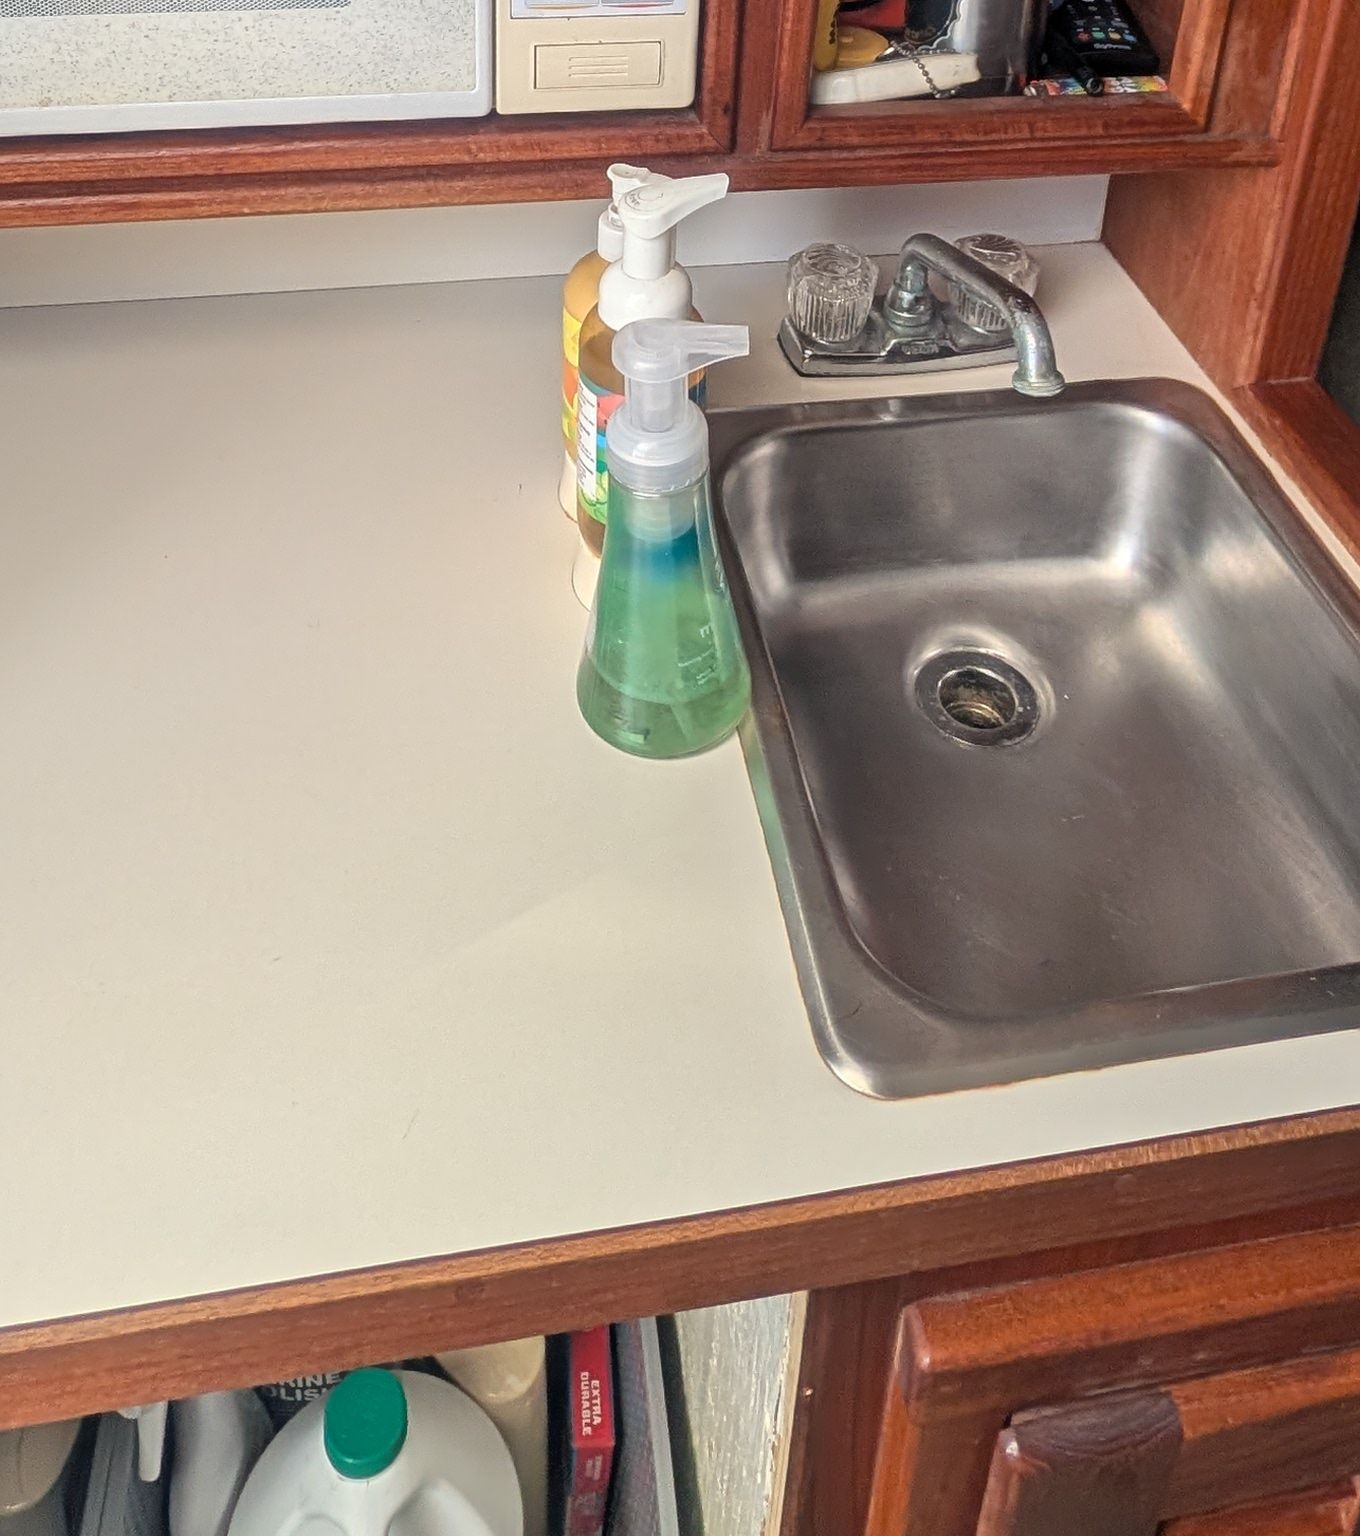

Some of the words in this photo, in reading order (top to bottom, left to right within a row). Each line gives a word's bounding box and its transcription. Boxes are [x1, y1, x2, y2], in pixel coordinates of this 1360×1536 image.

[267, 1387, 327, 1401] OLIS
[276, 1370, 342, 1387] RINE
[580, 1371, 592, 1436] DURABLE
[591, 1380, 602, 1425] EXTRA
